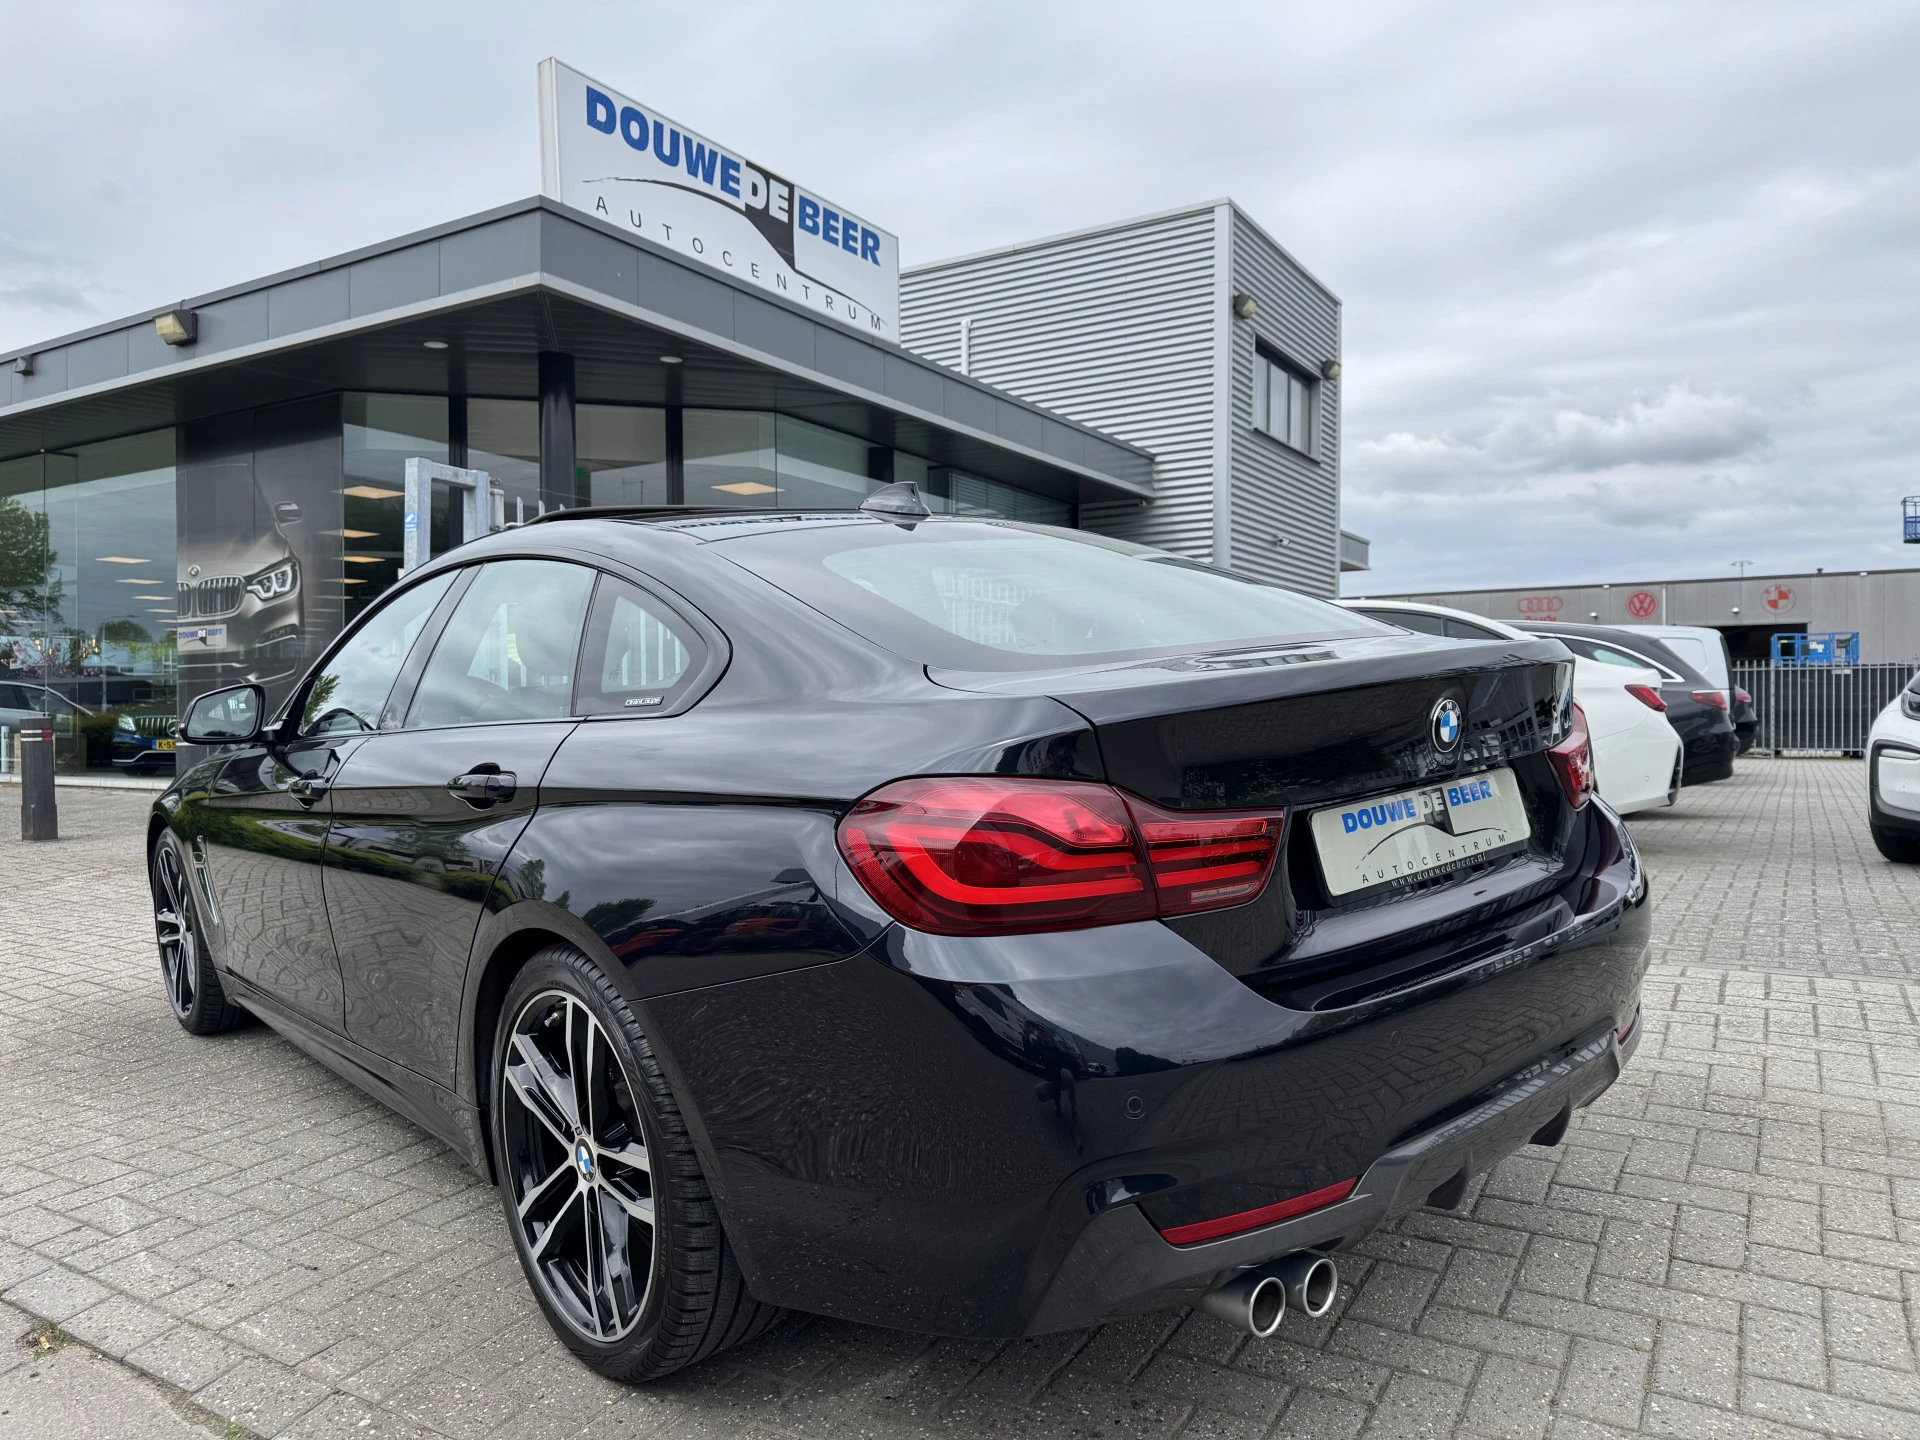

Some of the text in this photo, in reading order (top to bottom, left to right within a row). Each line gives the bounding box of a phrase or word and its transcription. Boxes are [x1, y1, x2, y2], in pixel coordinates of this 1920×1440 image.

[586, 85, 881, 268] DOUWE DE BEER
[596, 196, 881, 331] AUTOCENTRUM
[1341, 780, 1493, 834] DOUWE DE BEER
[1361, 833, 1506, 884] AUTOCENTRUM
[1391, 852, 1487, 888] www.douwedebeer.nl
